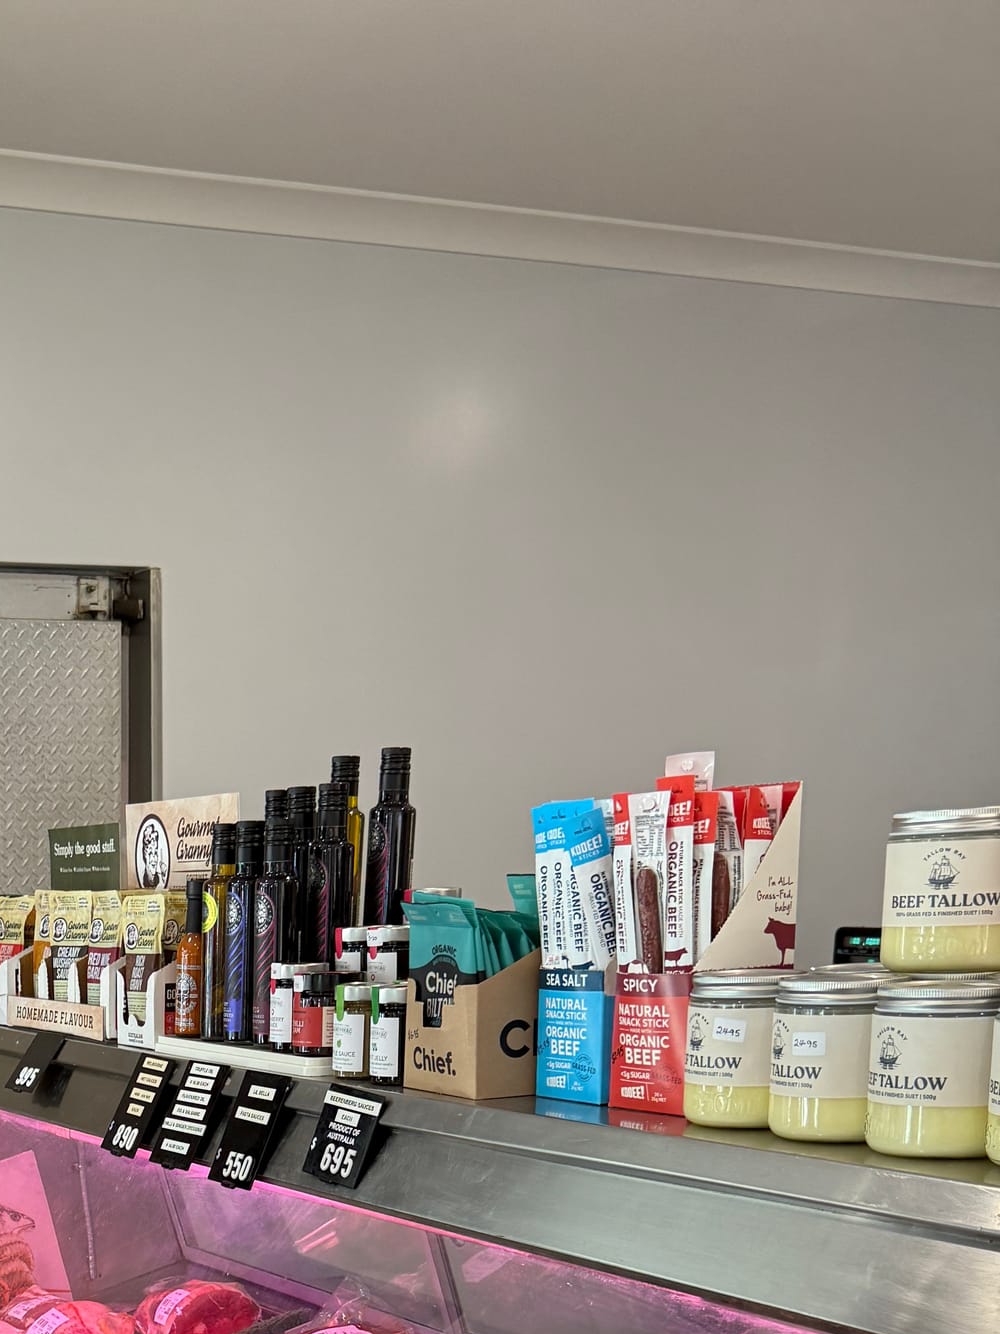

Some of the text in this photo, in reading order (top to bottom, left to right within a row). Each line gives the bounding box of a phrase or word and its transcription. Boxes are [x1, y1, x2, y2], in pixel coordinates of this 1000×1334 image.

[177, 816, 220, 838] Gourme
[54, 838, 116, 858] Simply the good stuff.
[923, 847, 967, 862] TALLOW BAY
[779, 876, 794, 886] ALL
[540, 865, 548, 922] ORGANIC
[554, 862, 563, 919] ORGANIC
[667, 841, 679, 938] ORGANIC BEEF
[892, 892, 1000, 909] BEEF TALLOW
[590, 873, 617, 957] ORGANIC BEE
[774, 902, 793, 916] baby!
[573, 922, 584, 953] BEEF
[432, 944, 457, 958] ORGANIC
[546, 973, 588, 987] SEA SALT
[623, 978, 658, 993] SPICY
[545, 997, 588, 1011] NATURAL
[619, 1003, 670, 1018] NATURAL
[16, 1006, 58, 1024] HOMEMADE
[59, 1012, 94, 1029] FLAVOUR
[545, 1010, 587, 1021] SNACK STICK
[619, 1016, 669, 1028] SNACK STICK
[545, 1025, 587, 1040] ORGANIC
[550, 1040, 580, 1057] BEEF
[619, 1033, 670, 1049] ORGANIC
[413, 1046, 457, 1077] Chief.
[625, 1047, 662, 1066] BEEF
[690, 1055, 742, 1069] TALLOW
[630, 1071, 650, 1080] SUGAR
[771, 1063, 822, 1080] TALLOW
[879, 1073, 948, 1090] TALLOW
[328, 1121, 361, 1137] PRODUCT OF
[326, 1131, 355, 1146] AUSTRALIA
